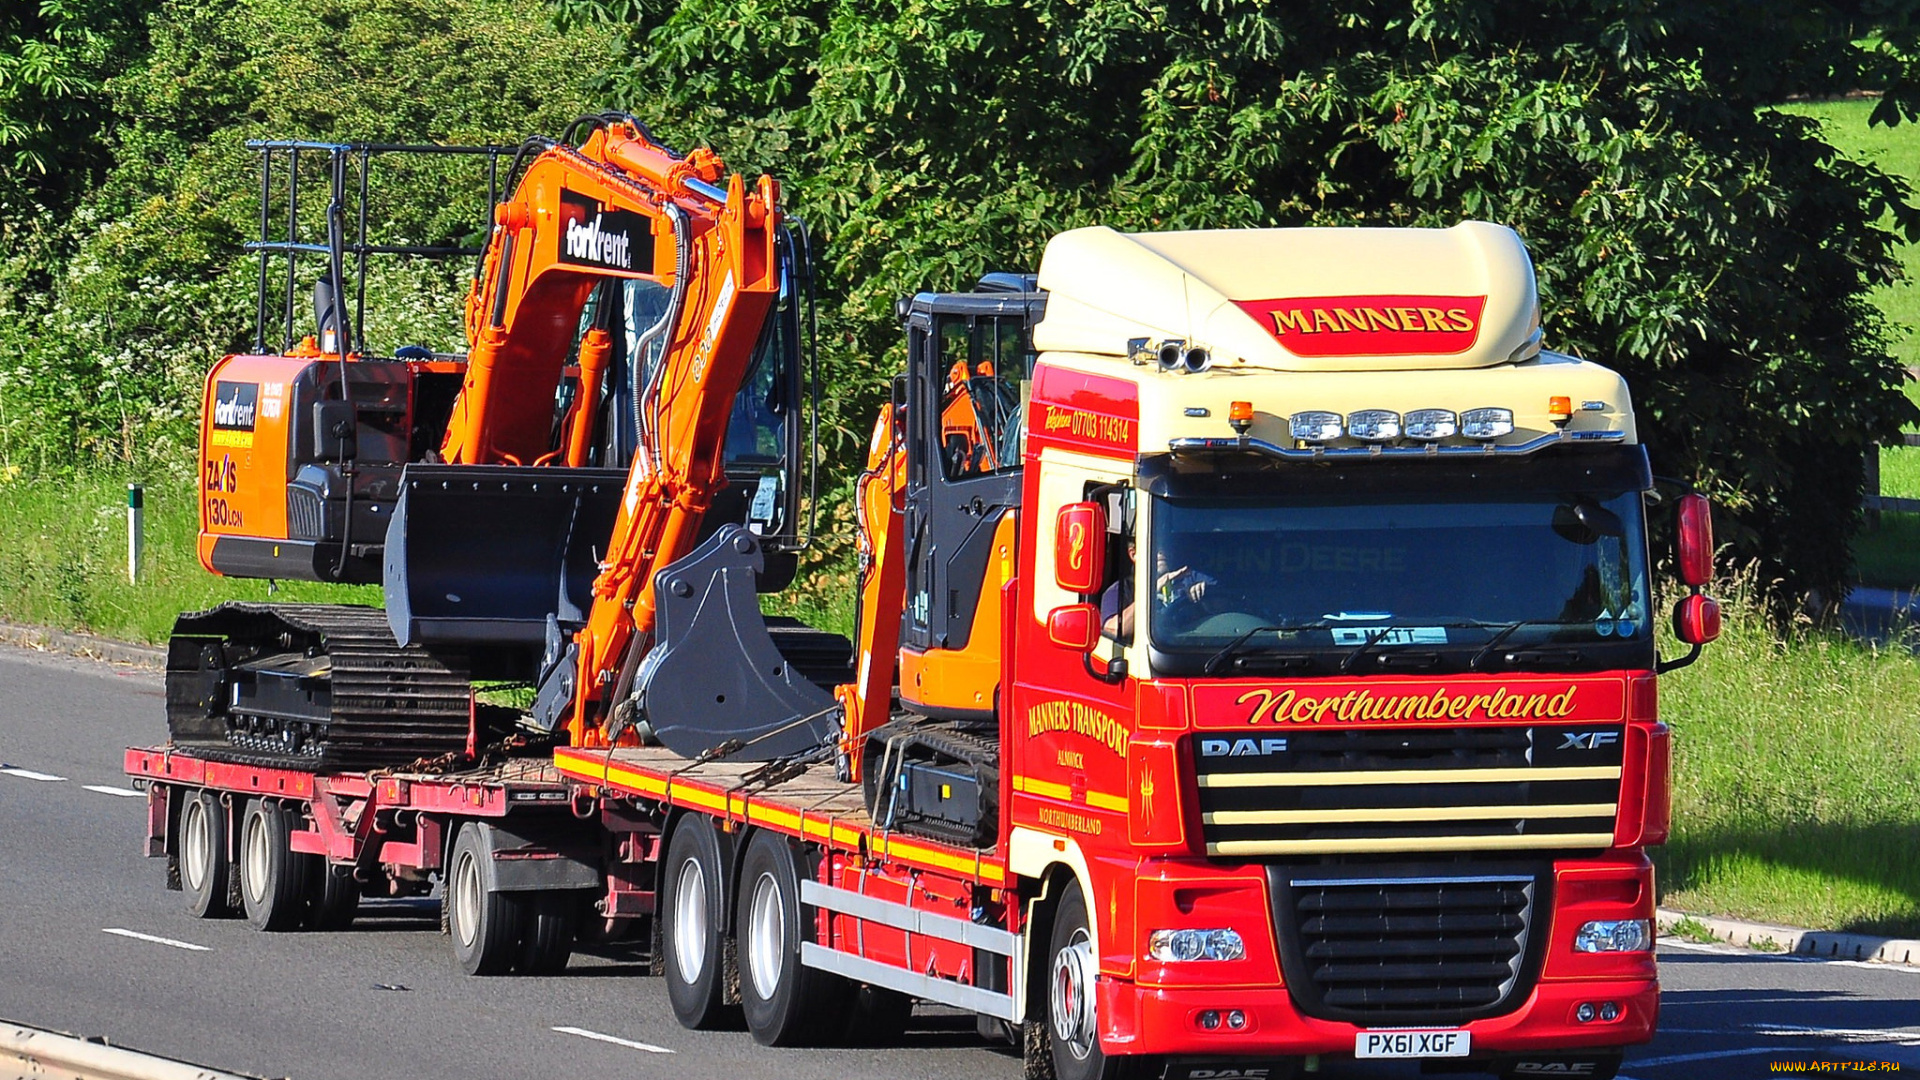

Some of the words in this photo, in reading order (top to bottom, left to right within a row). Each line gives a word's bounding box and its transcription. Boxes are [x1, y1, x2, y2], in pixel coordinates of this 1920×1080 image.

[1270, 307, 1474, 336] MANNERS
[1072, 410, 1097, 438] 07703
[1099, 416, 1129, 443] 114314
[1237, 685, 1577, 724] Northumberland
[1028, 700, 1070, 739] MANNERS
[1072, 701, 1129, 758] TRANSPORT
[1201, 738, 1287, 757] DAF
[1556, 731, 1618, 750] XF
[1057, 750, 1083, 770] ALNWICK
[1038, 807, 1102, 835] NORTHUMBERLAND
[1368, 1035, 1412, 1054] PX61
[1419, 1034, 1457, 1053] XGF
[1189, 1069, 1270, 1079] DAF
[1516, 1062, 1596, 1071] DAF
